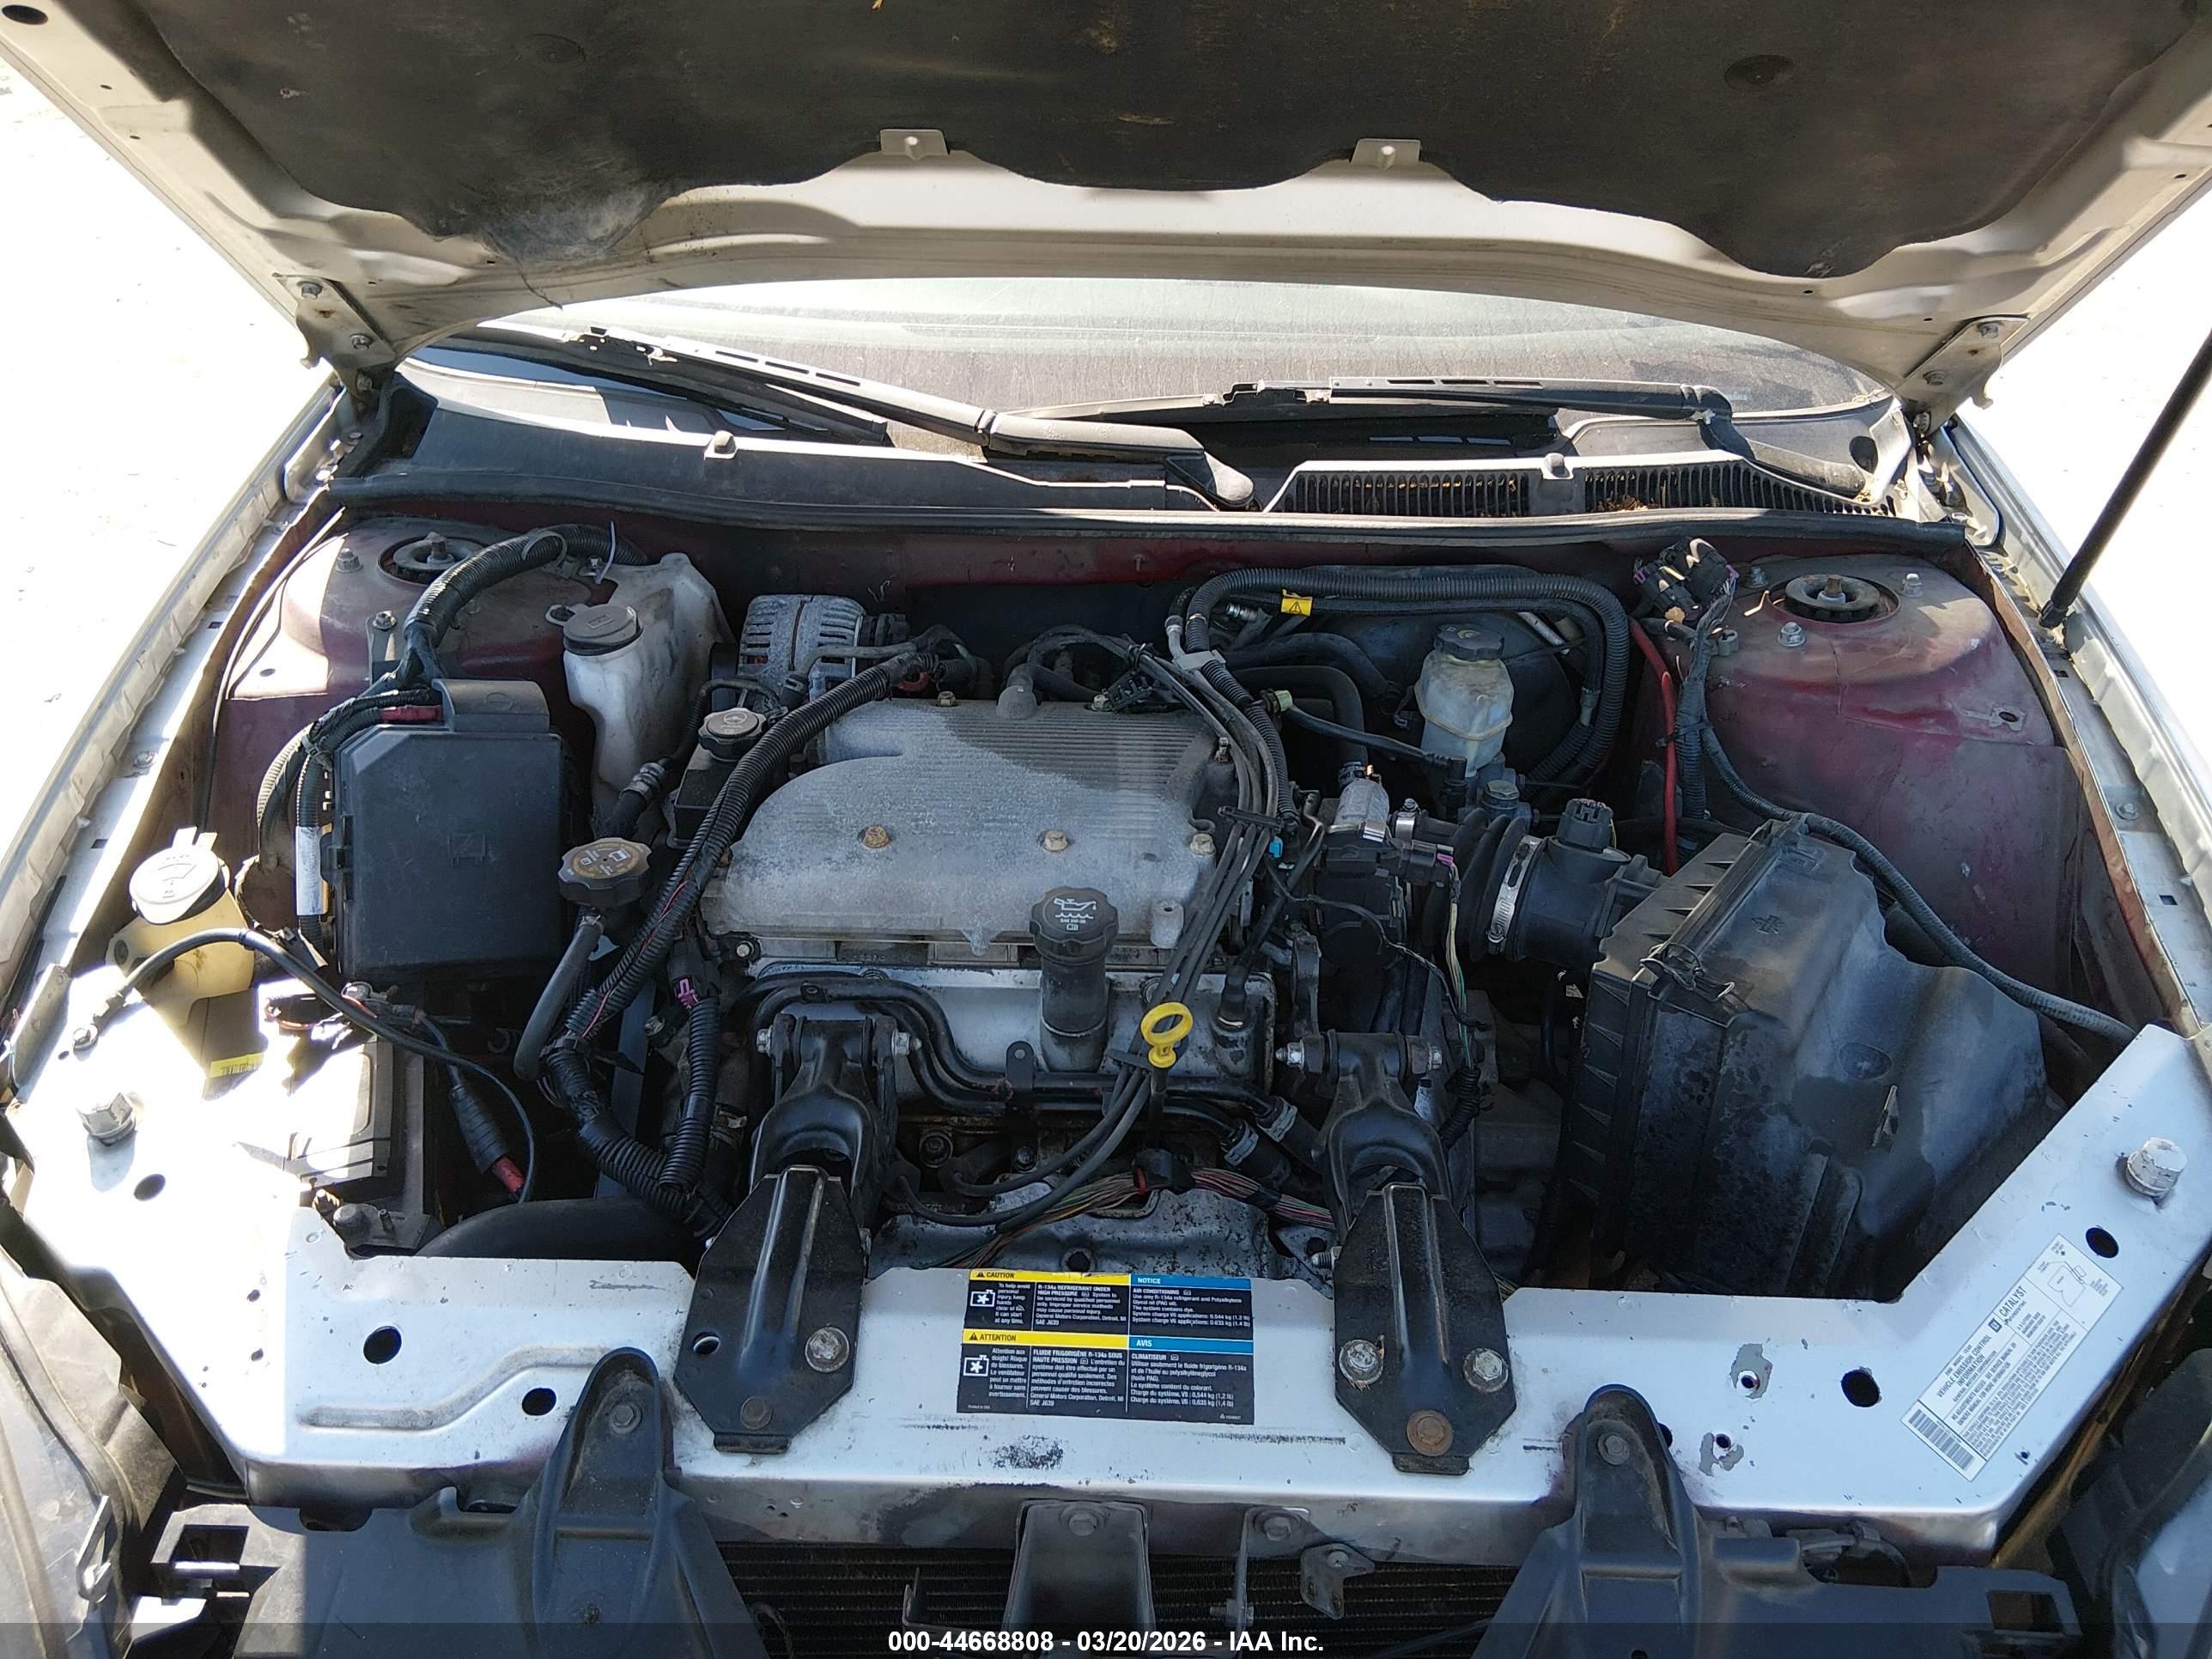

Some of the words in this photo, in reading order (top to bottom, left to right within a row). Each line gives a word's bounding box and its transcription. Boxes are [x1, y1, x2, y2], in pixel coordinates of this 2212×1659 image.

[1997, 1285, 2027, 1317] CATALYST
[1936, 1376, 1955, 1398] VEHICLE
[1952, 1353, 1974, 1378] EMISSION
[1971, 1334, 1991, 1356] CONTROL
[1955, 1352, 1984, 1387] INFORMATION
